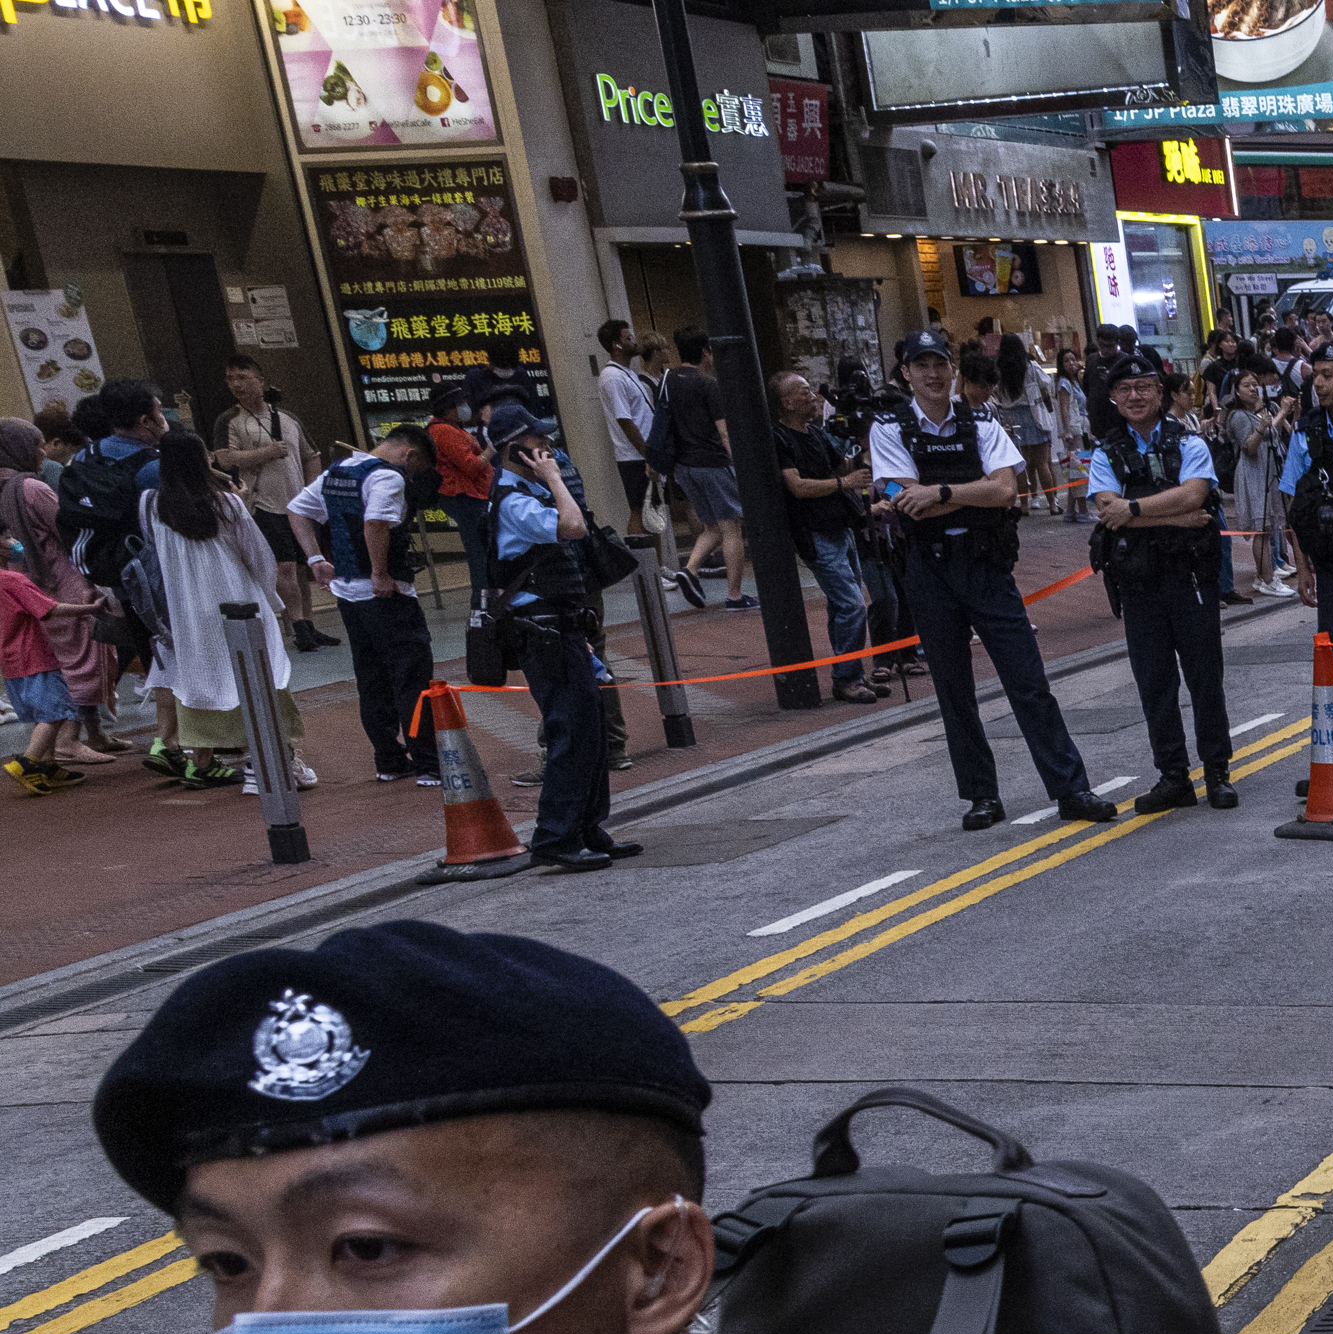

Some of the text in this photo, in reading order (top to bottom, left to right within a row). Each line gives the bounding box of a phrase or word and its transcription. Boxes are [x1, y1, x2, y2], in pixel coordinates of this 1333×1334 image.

[343, 15, 371, 26] 12:30
[378, 13, 407, 25] 23:30
[1169, 104, 1216, 118] Plaza
[1222, 93, 1333, 118] 翡翠明珠廣場
[1212, 169, 1225, 185] WEI
[950, 170, 995, 210] MR.
